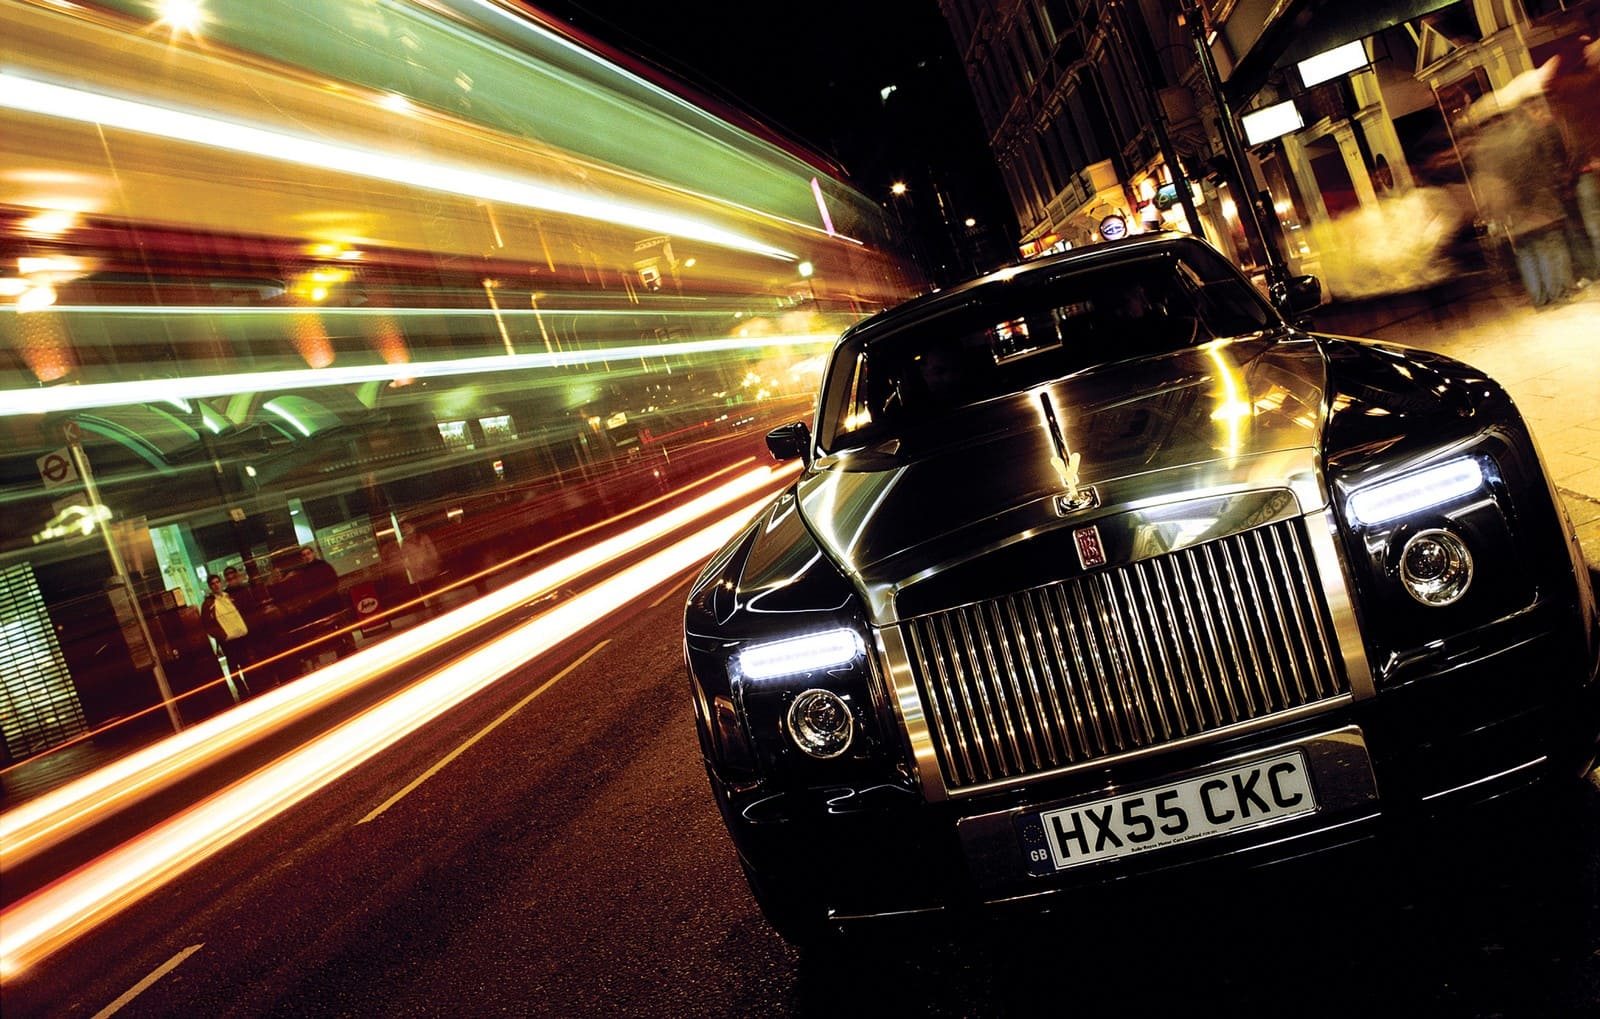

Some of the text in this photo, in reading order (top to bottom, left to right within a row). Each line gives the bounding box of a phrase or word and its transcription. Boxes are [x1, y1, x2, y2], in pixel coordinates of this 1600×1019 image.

[1051, 762, 1302, 858] HX55 CKC
[1185, 833, 1202, 841] Limited
[1031, 848, 1048, 862] GB
